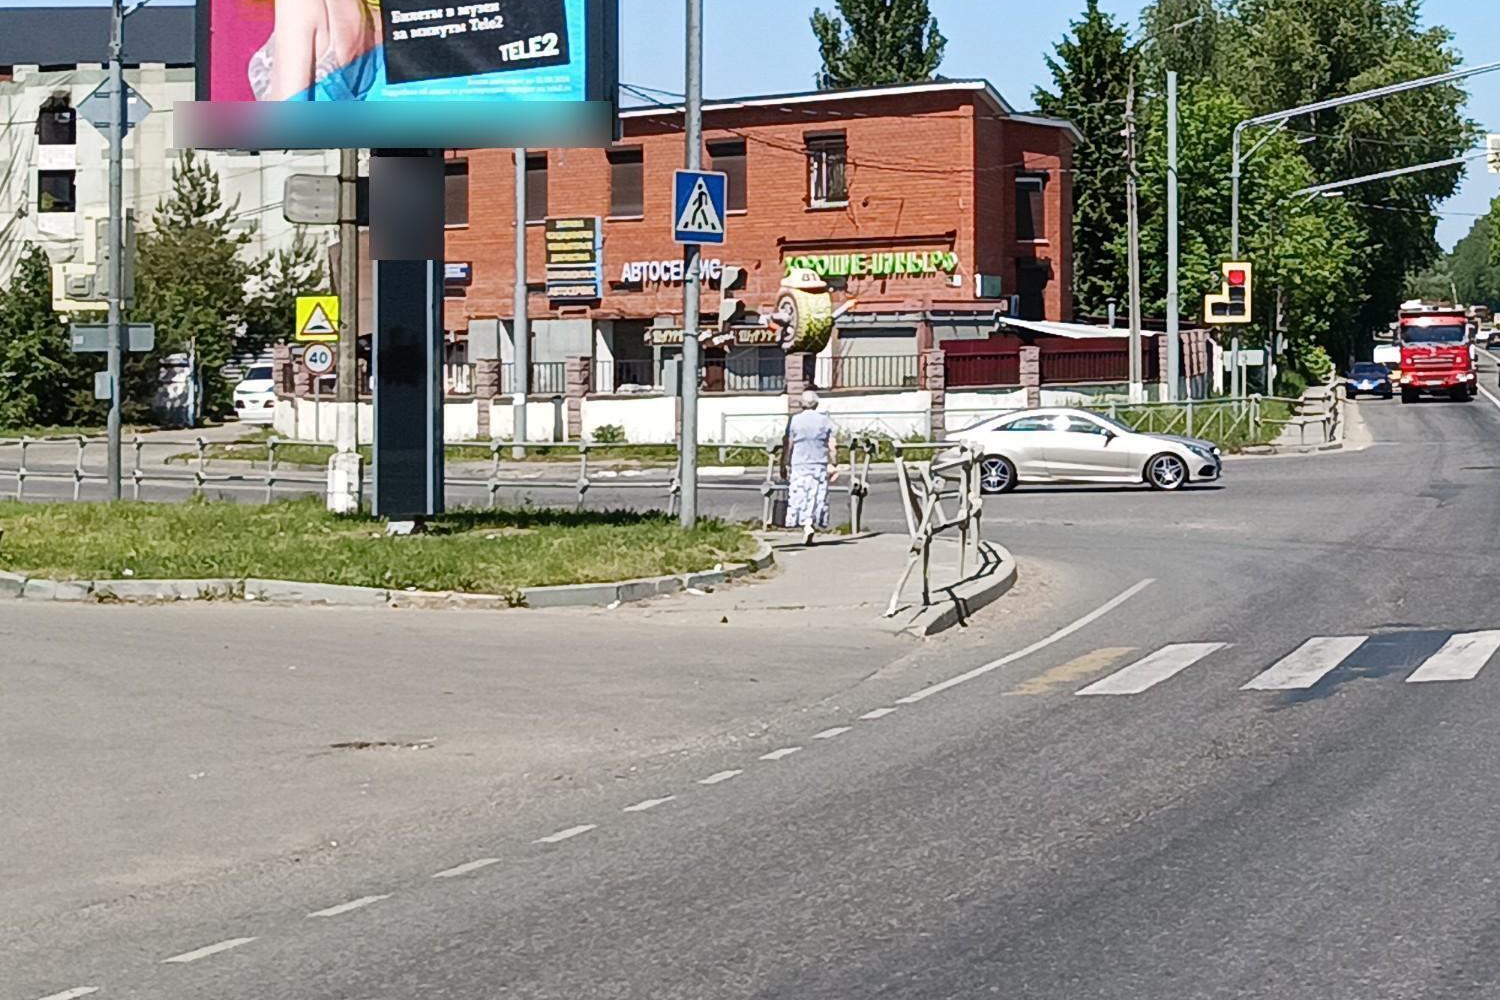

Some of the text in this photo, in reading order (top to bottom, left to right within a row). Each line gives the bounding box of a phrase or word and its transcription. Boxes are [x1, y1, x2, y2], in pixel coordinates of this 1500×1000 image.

[446, 7, 455, 17] в
[393, 15, 504, 41] за минуты Tele2
[499, 32, 560, 61] TELE2
[621, 259, 721, 282] АВТОСЕИС
[309, 351, 329, 364] 40
